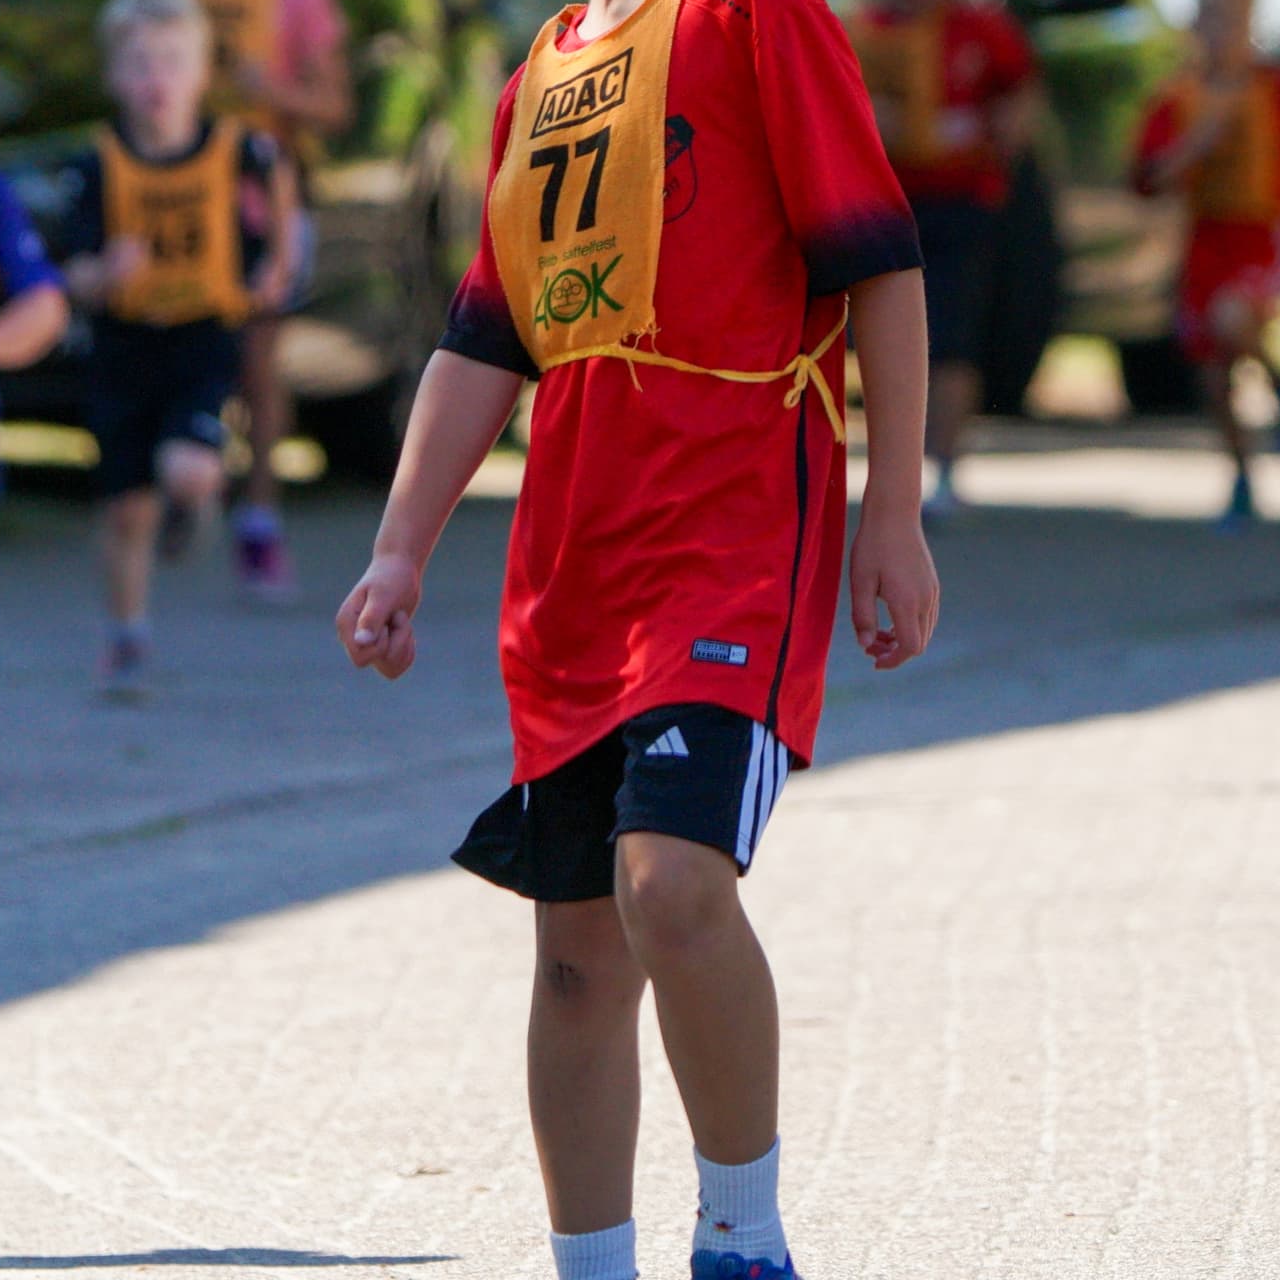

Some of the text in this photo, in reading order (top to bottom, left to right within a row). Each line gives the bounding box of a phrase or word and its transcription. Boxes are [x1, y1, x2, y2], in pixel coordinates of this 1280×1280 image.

[540, 65, 621, 128] ADAC
[529, 124, 611, 242] 77
[534, 252, 624, 330] AOK
